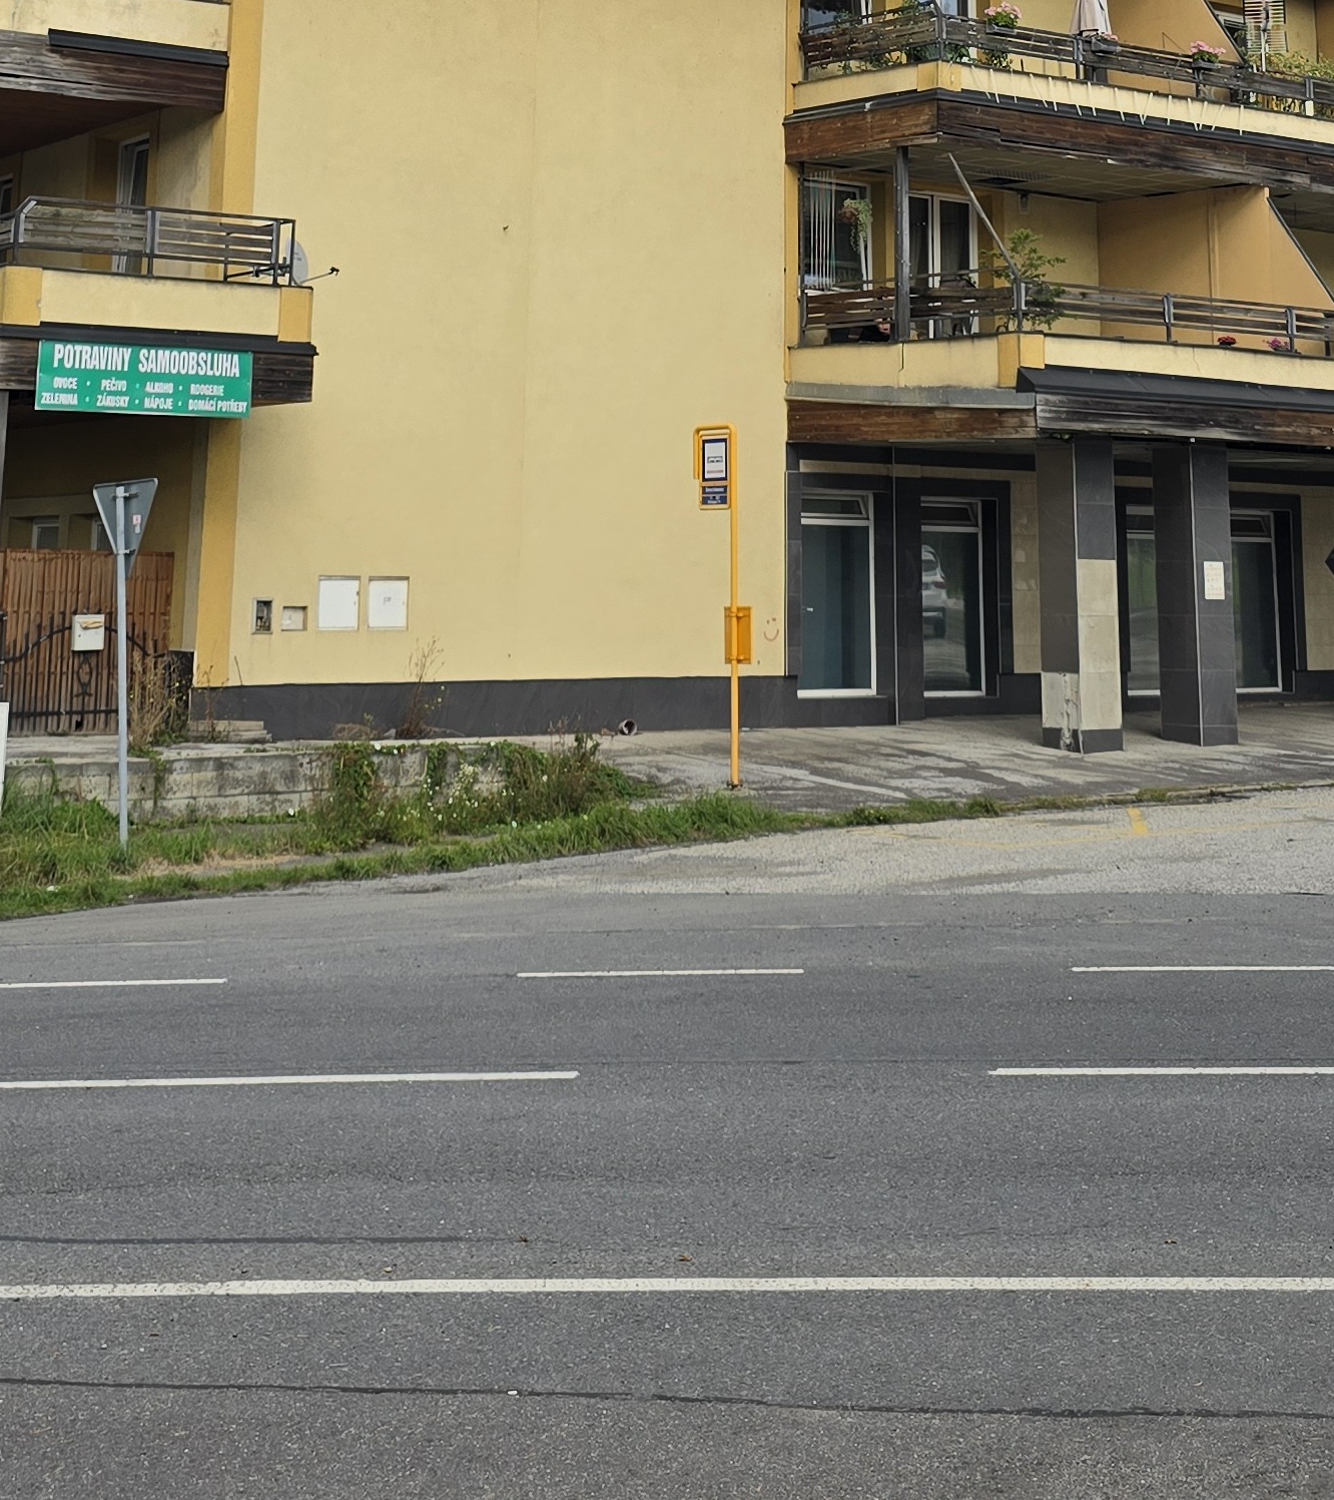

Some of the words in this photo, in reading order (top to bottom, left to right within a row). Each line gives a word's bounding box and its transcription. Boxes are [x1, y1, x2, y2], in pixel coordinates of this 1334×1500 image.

[53, 344, 131, 372] POTRAVINY
[138, 349, 240, 377] SAMOOBSLUHA
[53, 377, 78, 389] OVOCE
[100, 377, 127, 392] PEČIVO
[144, 395, 174, 410] NÁPOJE
